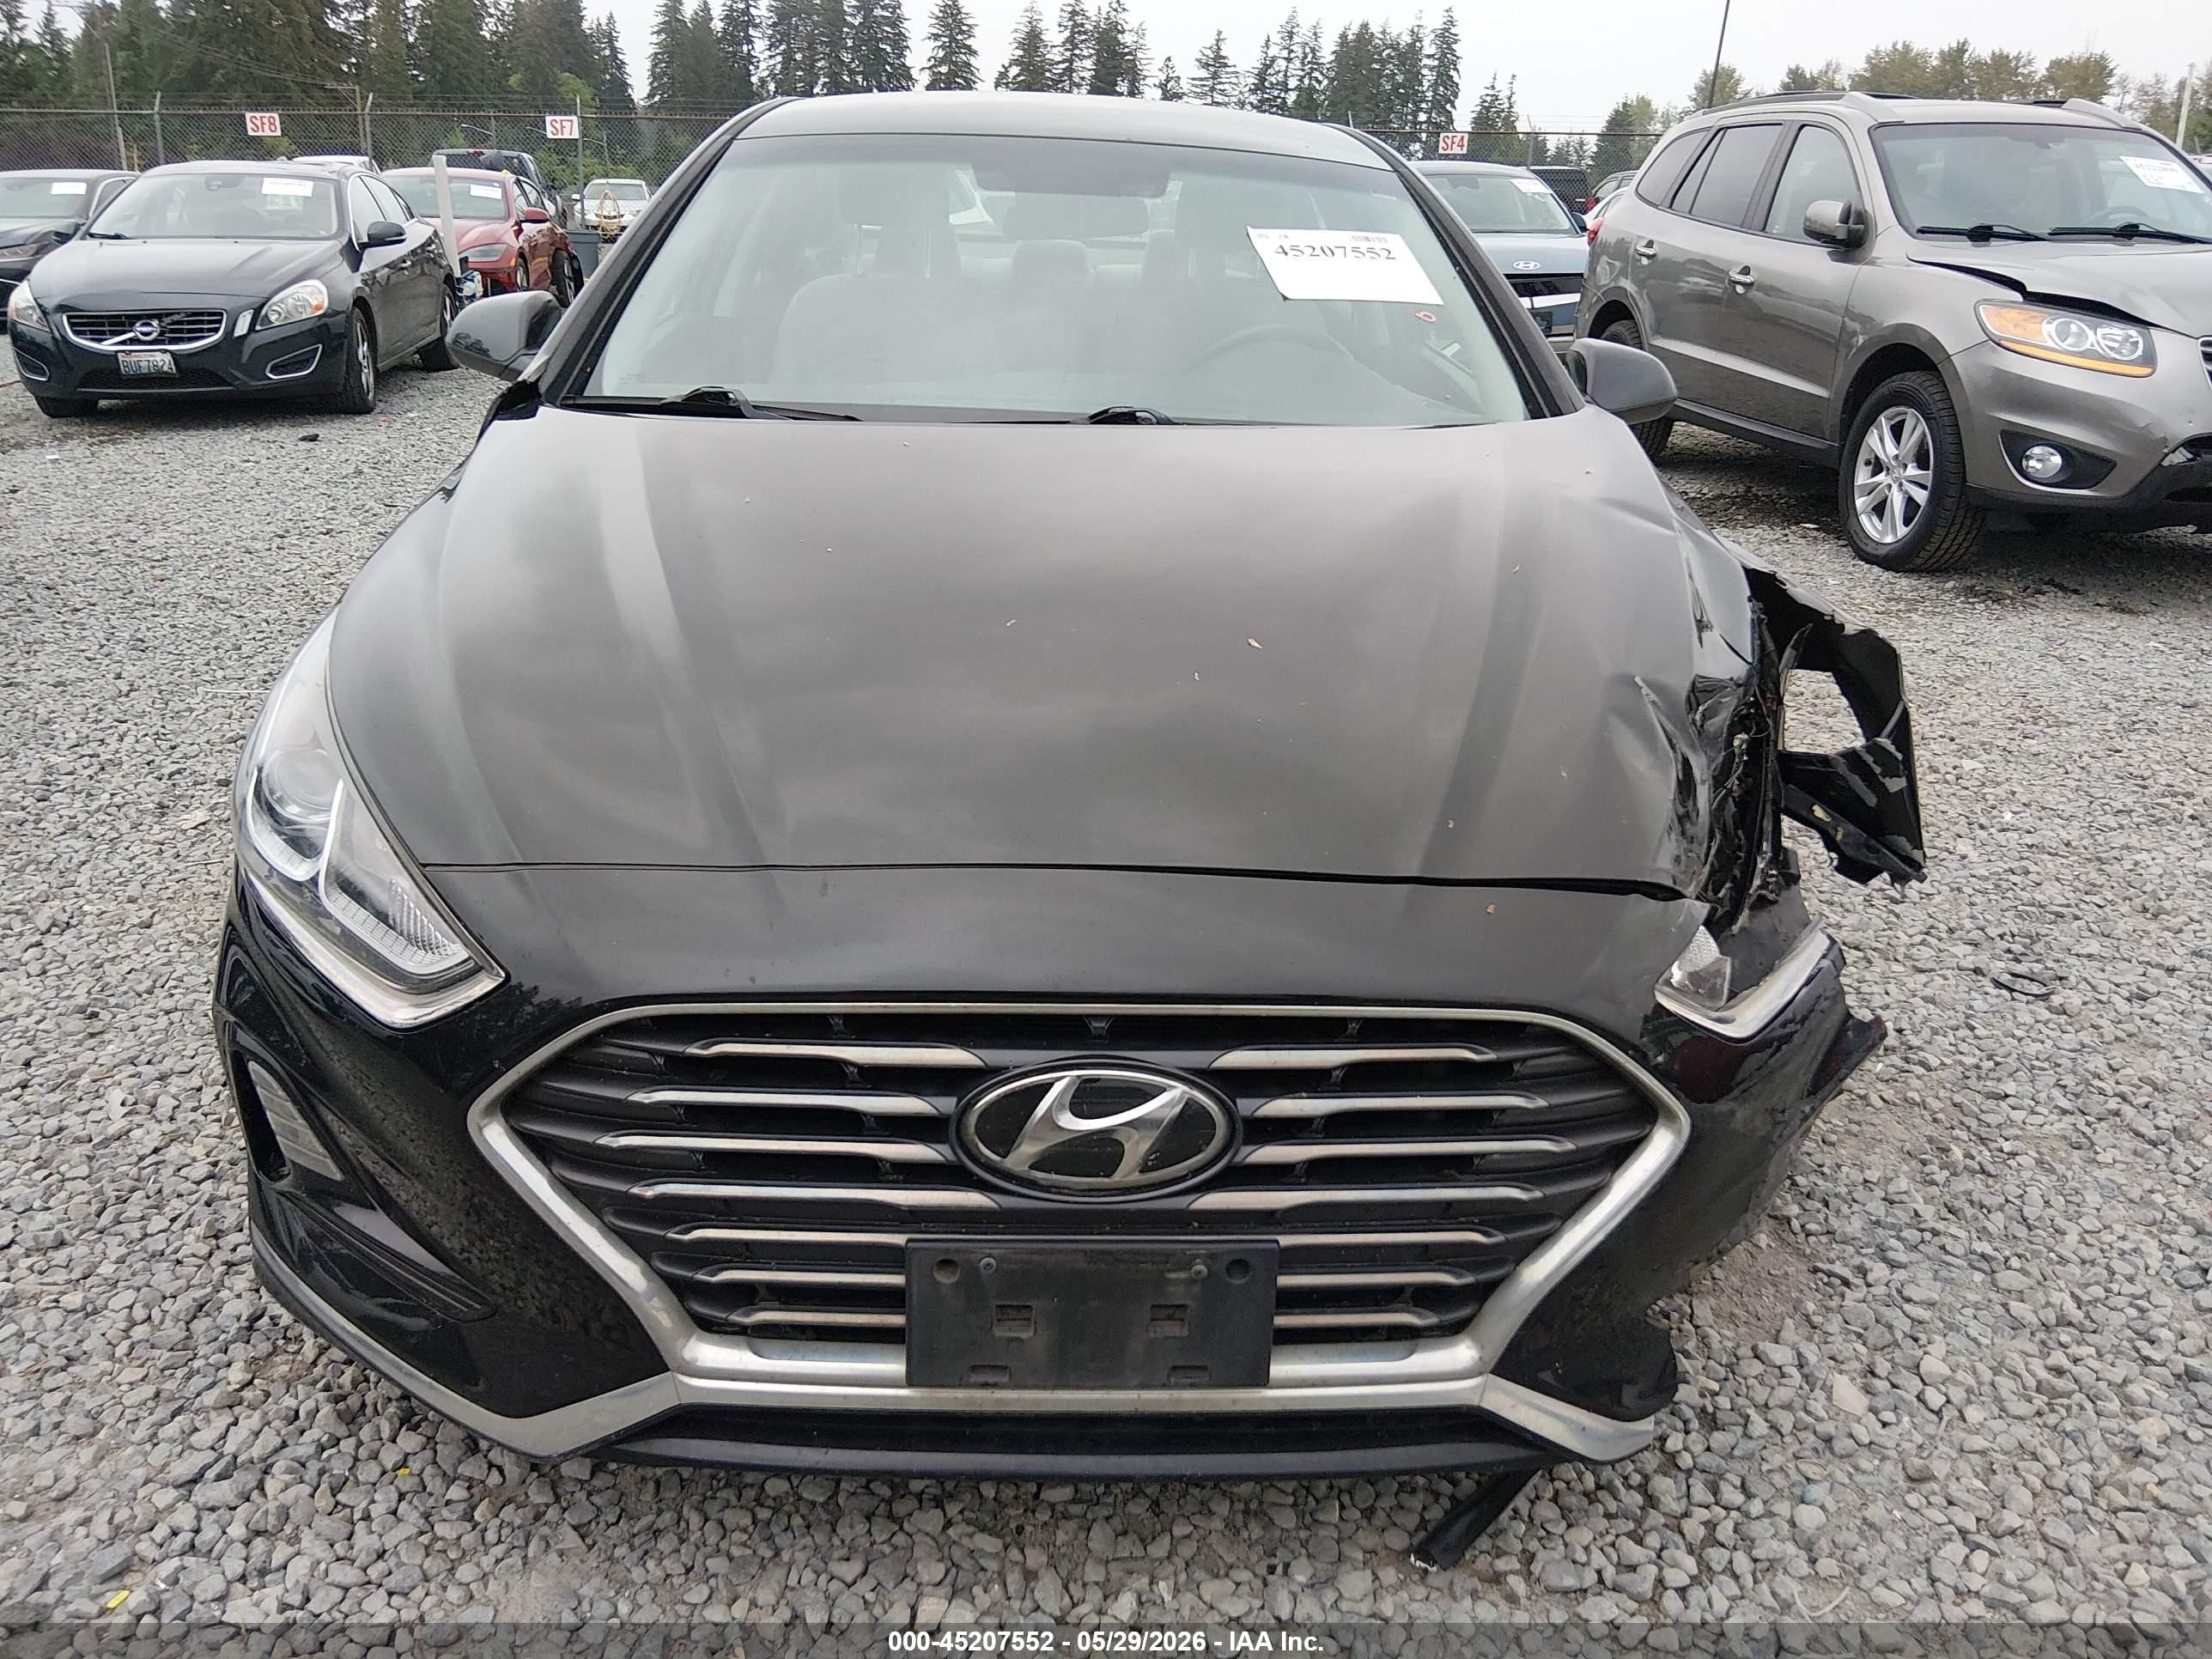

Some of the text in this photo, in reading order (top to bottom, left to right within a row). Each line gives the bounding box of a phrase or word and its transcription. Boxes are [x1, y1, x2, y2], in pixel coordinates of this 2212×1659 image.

[249, 115, 277, 133] SF8
[550, 118, 574, 137] SF7
[1441, 135, 1465, 152] SF4
[1274, 244, 1396, 260] 45207552
